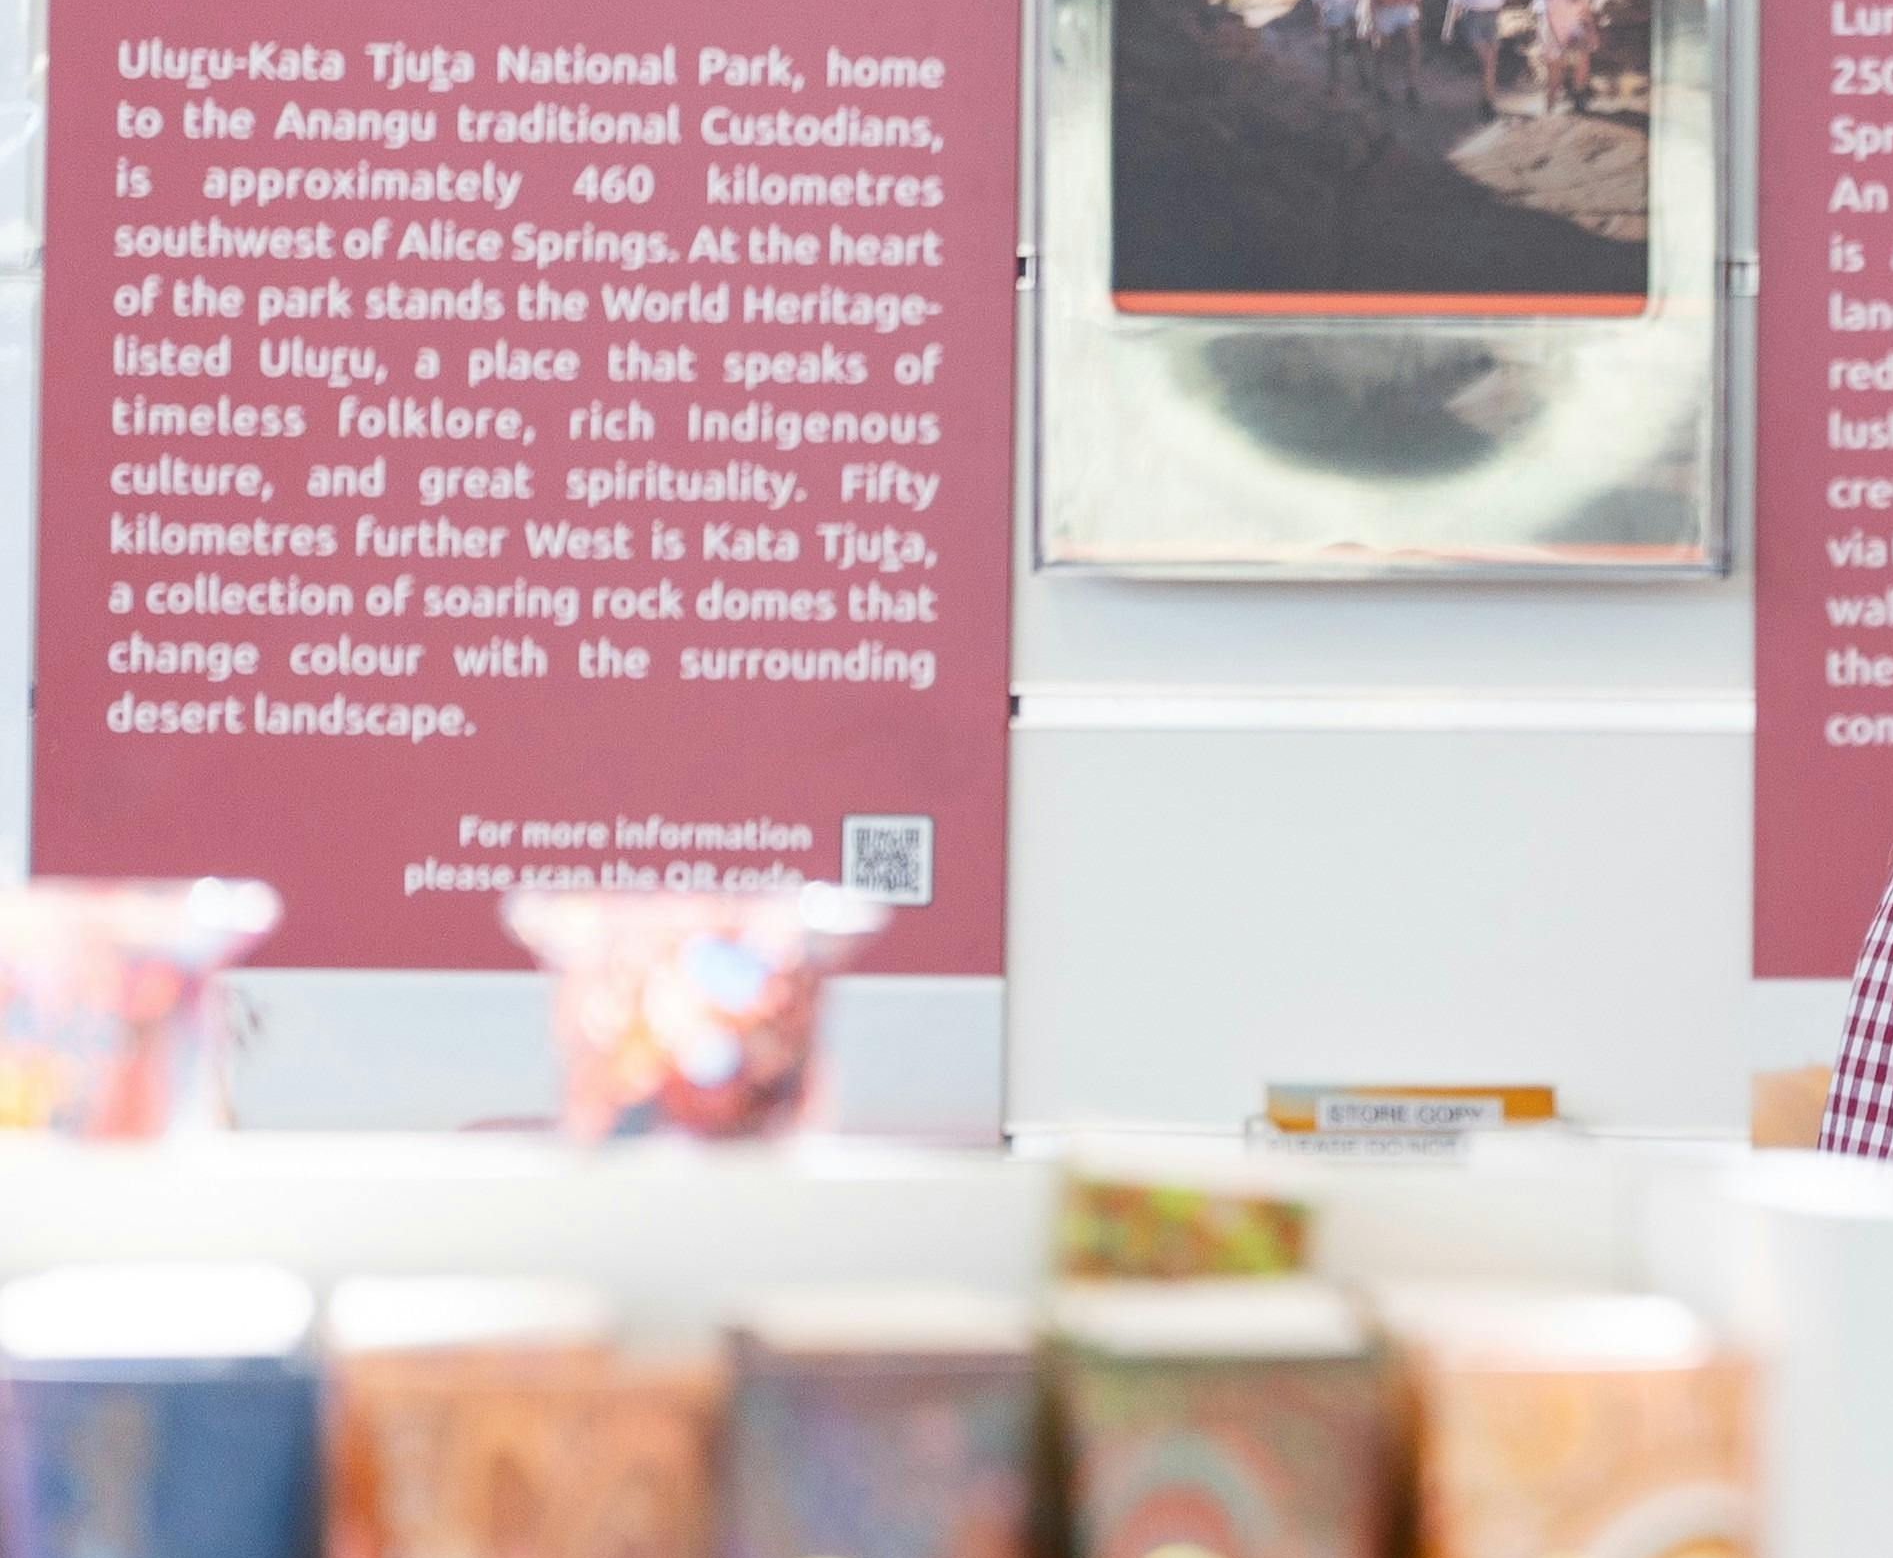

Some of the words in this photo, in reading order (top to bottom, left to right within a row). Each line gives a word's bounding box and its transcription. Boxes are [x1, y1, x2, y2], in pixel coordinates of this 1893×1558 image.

[497, 44, 677, 86] National
[698, 46, 805, 92] Park,
[826, 47, 945, 89] home
[117, 101, 163, 138] to
[183, 98, 255, 139] the
[274, 102, 437, 149] Anangu
[457, 102, 681, 145] traditional
[700, 106, 944, 153] Custodians,
[116, 158, 151, 198] is
[203, 161, 522, 210] approximately
[573, 164, 655, 204] 460
[706, 164, 944, 207] kilometres
[1829, 176, 1889, 212] An
[115, 217, 333, 259] southwest
[343, 218, 390, 260] of
[397, 220, 503, 261] Alice
[511, 222, 679, 271] Springs.
[688, 226, 739, 264] At
[748, 224, 821, 266] the
[829, 225, 942, 267] heart
[1829, 235, 1865, 273] is
[113, 275, 160, 316] of
[173, 276, 245, 318] the
[258, 278, 351, 325] park
[365, 280, 505, 321] stands
[517, 280, 589, 322] the
[601, 282, 730, 324] World
[743, 285, 941, 333] Heritage-
[113, 335, 231, 377] listed
[414, 348, 440, 379] a
[467, 339, 580, 387] place
[607, 341, 695, 382] that
[723, 343, 868, 390] speaks
[894, 343, 942, 385] of
[112, 396, 306, 437] timeless
[338, 395, 536, 445] folklore,
[569, 400, 655, 441] rich
[687, 402, 941, 451] Indigenous
[110, 454, 273, 501] culture,
[307, 457, 386, 498] and
[418, 462, 532, 506] great
[566, 460, 807, 510] spirituality.
[841, 461, 940, 511] Fifty
[110, 514, 337, 556] kilometres
[355, 515, 507, 558] further
[524, 521, 632, 560] West
[651, 521, 686, 561] is
[702, 523, 800, 562] Kata
[108, 582, 133, 613] a
[145, 574, 354, 616] collection
[365, 574, 413, 616] of
[423, 578, 580, 627] soaring
[592, 579, 683, 620] rock
[695, 579, 837, 621] domes
[848, 581, 936, 623] that
[107, 633, 259, 682] change
[289, 634, 423, 676] colour
[453, 637, 548, 678] with
[578, 637, 650, 679] the
[680, 641, 936, 690] surrounding
[106, 692, 243, 734] desert
[254, 693, 475, 743] landscape.
[459, 815, 515, 847] For
[521, 819, 609, 850] more
[615, 815, 813, 851] information
